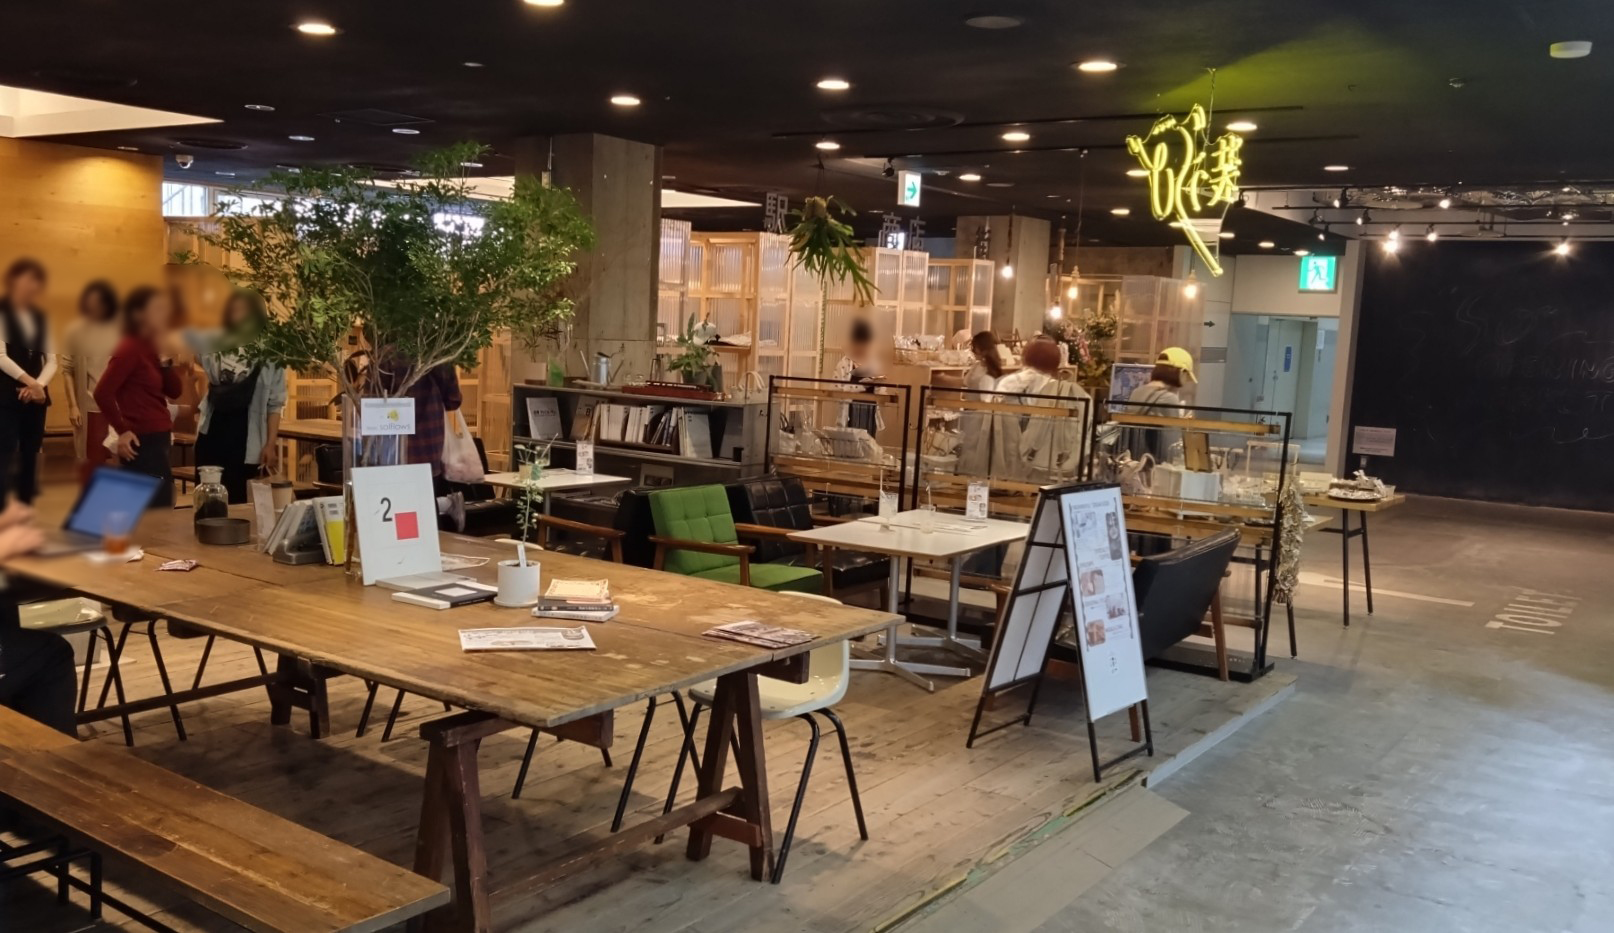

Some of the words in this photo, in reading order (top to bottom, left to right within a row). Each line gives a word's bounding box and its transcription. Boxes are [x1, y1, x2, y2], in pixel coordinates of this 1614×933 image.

[763, 192, 789, 234] 駅
[380, 497, 393, 523] 2
[1485, 586, 1583, 634] TOILET
